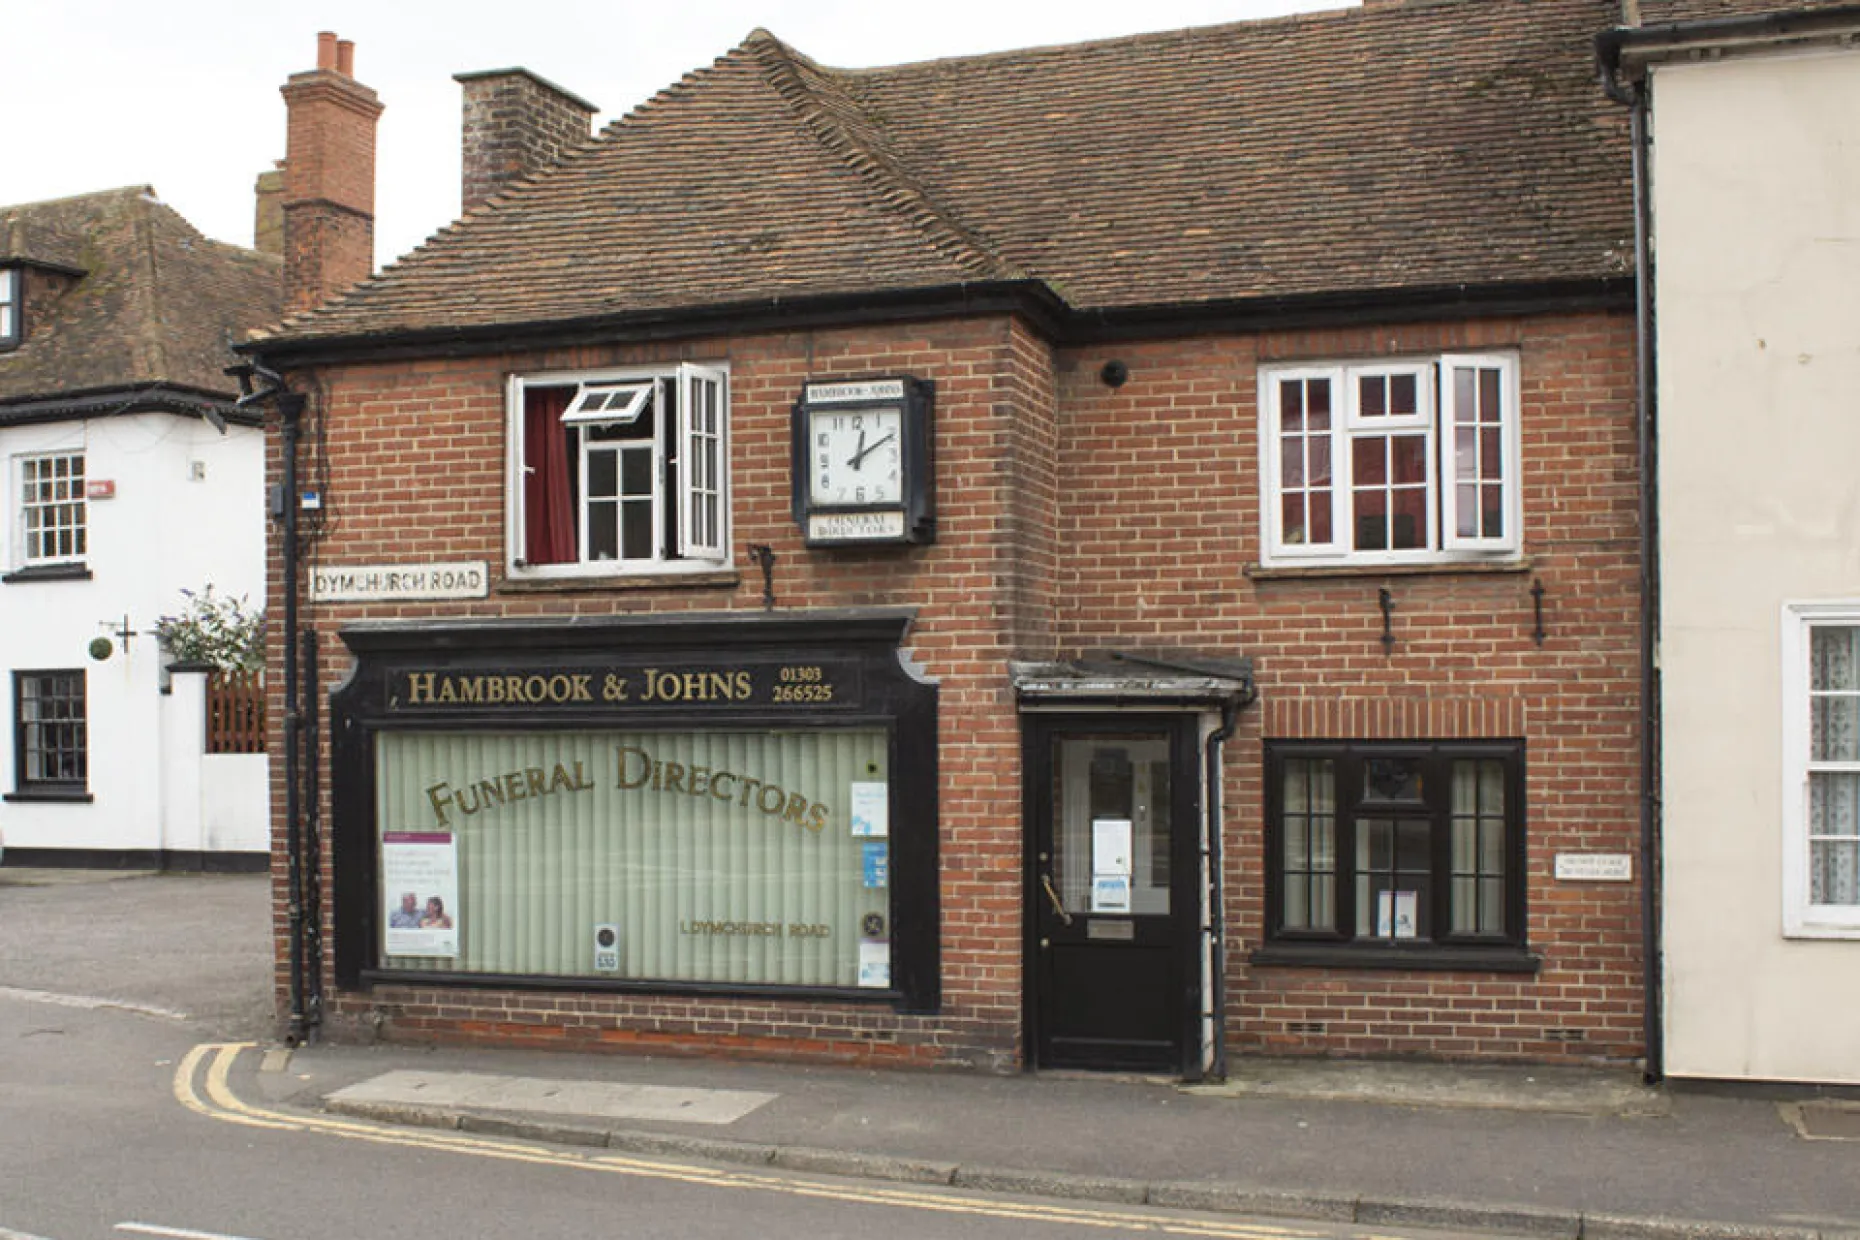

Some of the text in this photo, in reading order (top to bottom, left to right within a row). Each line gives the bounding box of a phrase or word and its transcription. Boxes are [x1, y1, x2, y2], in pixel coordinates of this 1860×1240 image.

[314, 569, 481, 594] DYMCHURCH ROAD
[408, 667, 753, 703] HAMBROOK & JOHNS
[780, 666, 822, 682] 01303
[772, 683, 832, 702] 266525
[425, 746, 830, 832] FUNERAL DIRECTORS
[788, 923, 831, 939] ROAD
